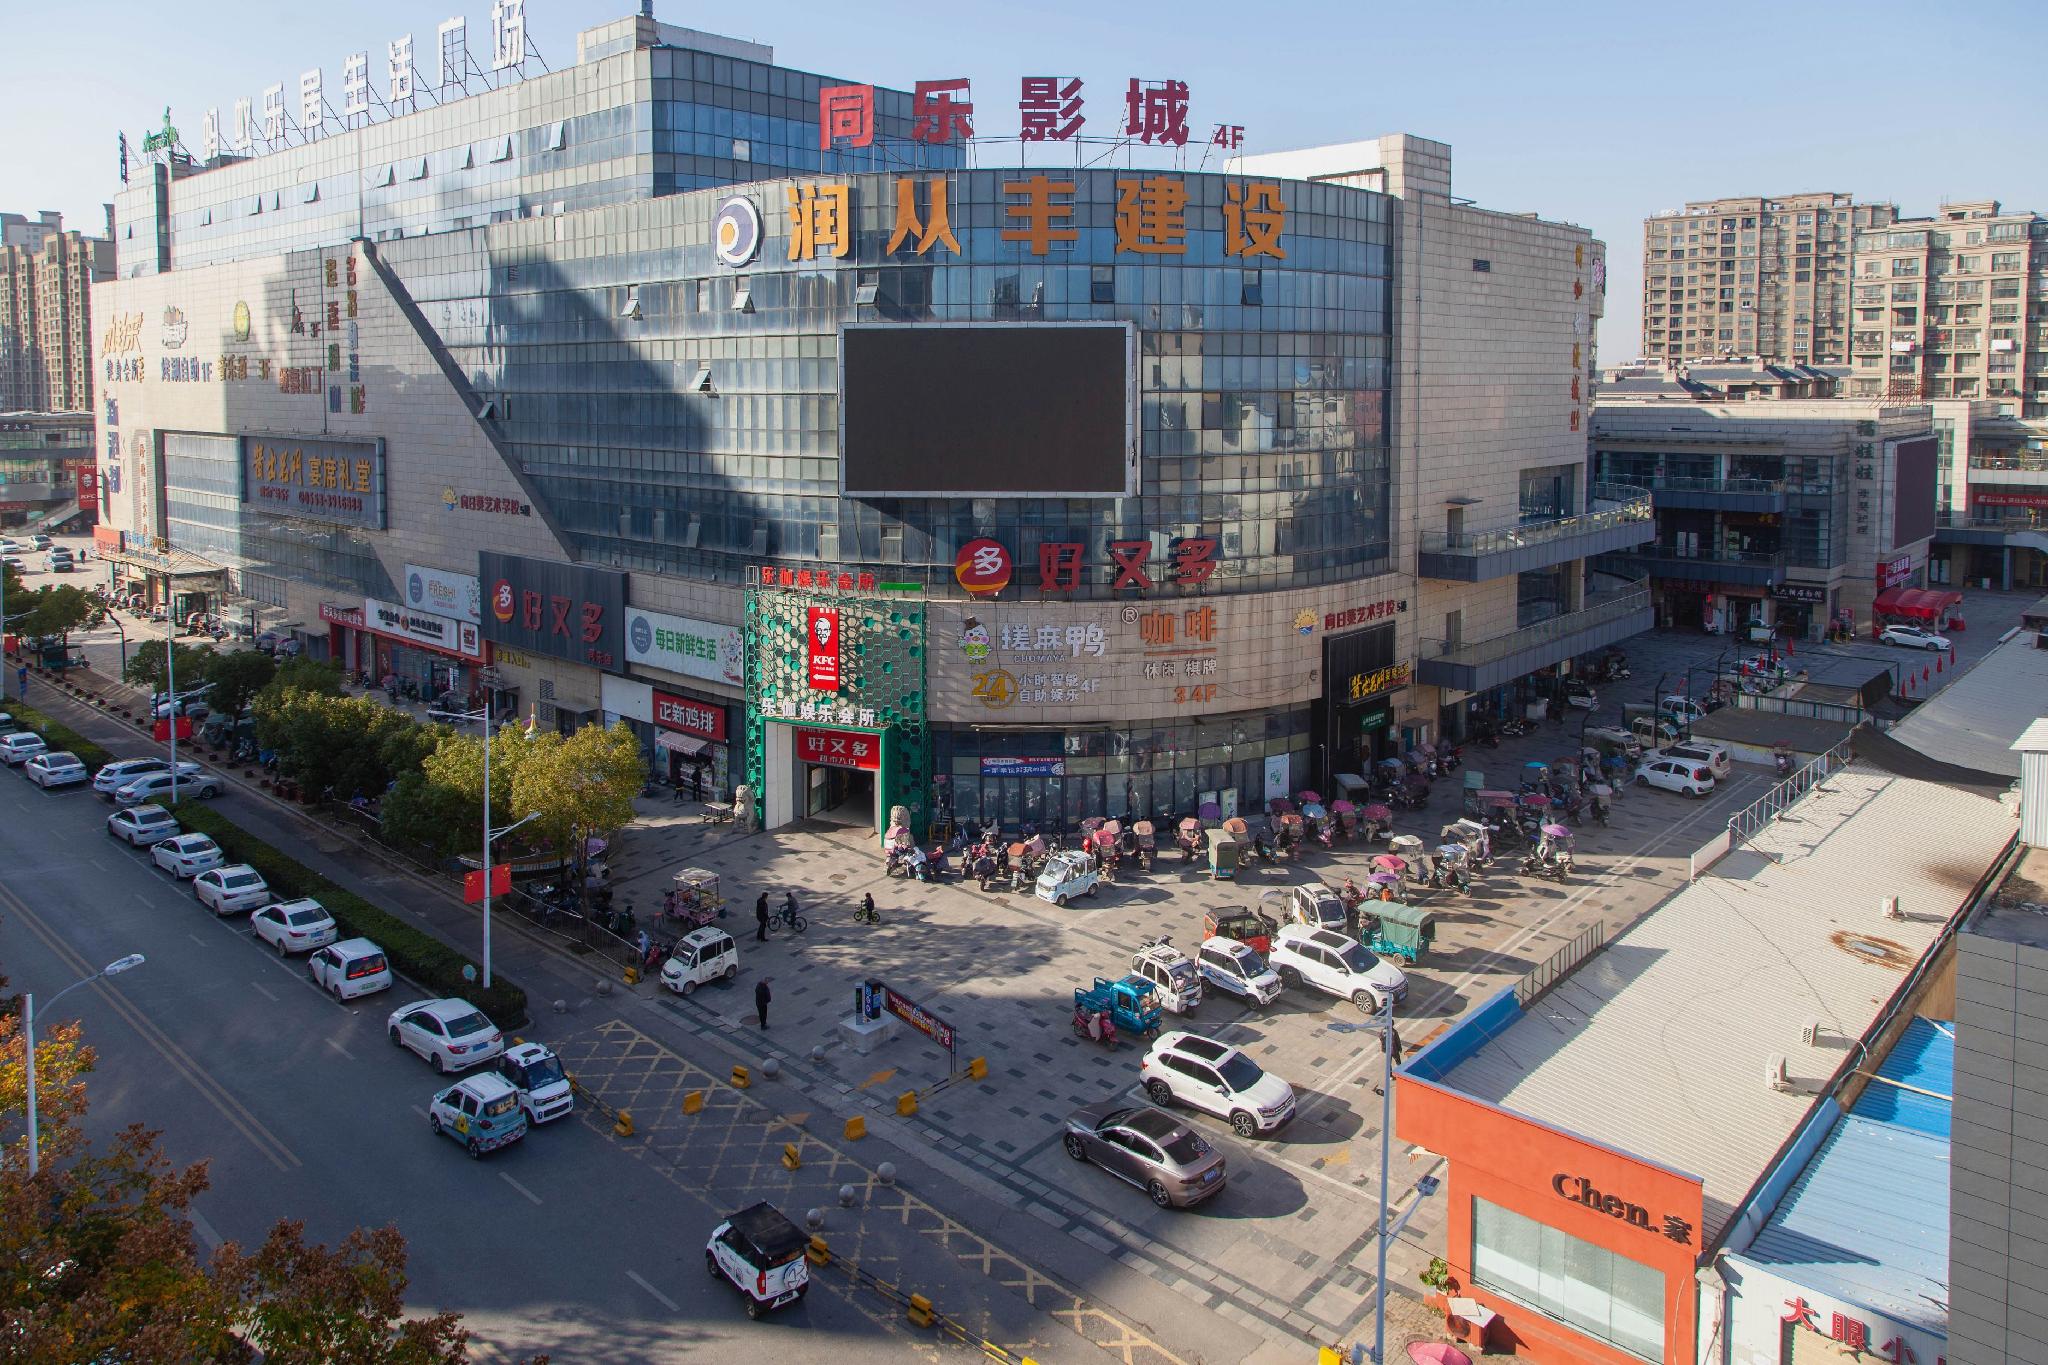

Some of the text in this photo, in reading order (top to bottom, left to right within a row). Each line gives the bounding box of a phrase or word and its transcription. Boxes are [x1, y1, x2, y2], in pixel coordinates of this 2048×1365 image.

[820, 77, 1245, 151] 同乐影城 4F
[787, 175, 1286, 260] 润从丰建设
[309, 455, 371, 493] 宴席礼堂
[762, 566, 875, 591] 乐伽娱乐会所
[1039, 539, 1218, 591] 好又多
[522, 588, 604, 643] 好又多
[1140, 606, 1217, 646] 咖啡
[1325, 599, 1395, 631] 向日葵艺术学校
[655, 626, 717, 661] 每日新鲜生活
[1001, 623, 1106, 657] 搓麻鸭
[813, 655, 836, 666] KFC
[1144, 658, 1217, 681] 休闲 棋牌
[971, 672, 1101, 702] 24 小时智能 4F
[1018, 688, 1079, 703] 自助娱乐
[659, 701, 715, 734] 正新鸡排
[761, 697, 875, 727] 乐伽娱乐会所
[808, 737, 869, 757] 好又多
[819, 754, 857, 767] 超市入口
[1784, 1296, 1946, 1365] 大眼小
